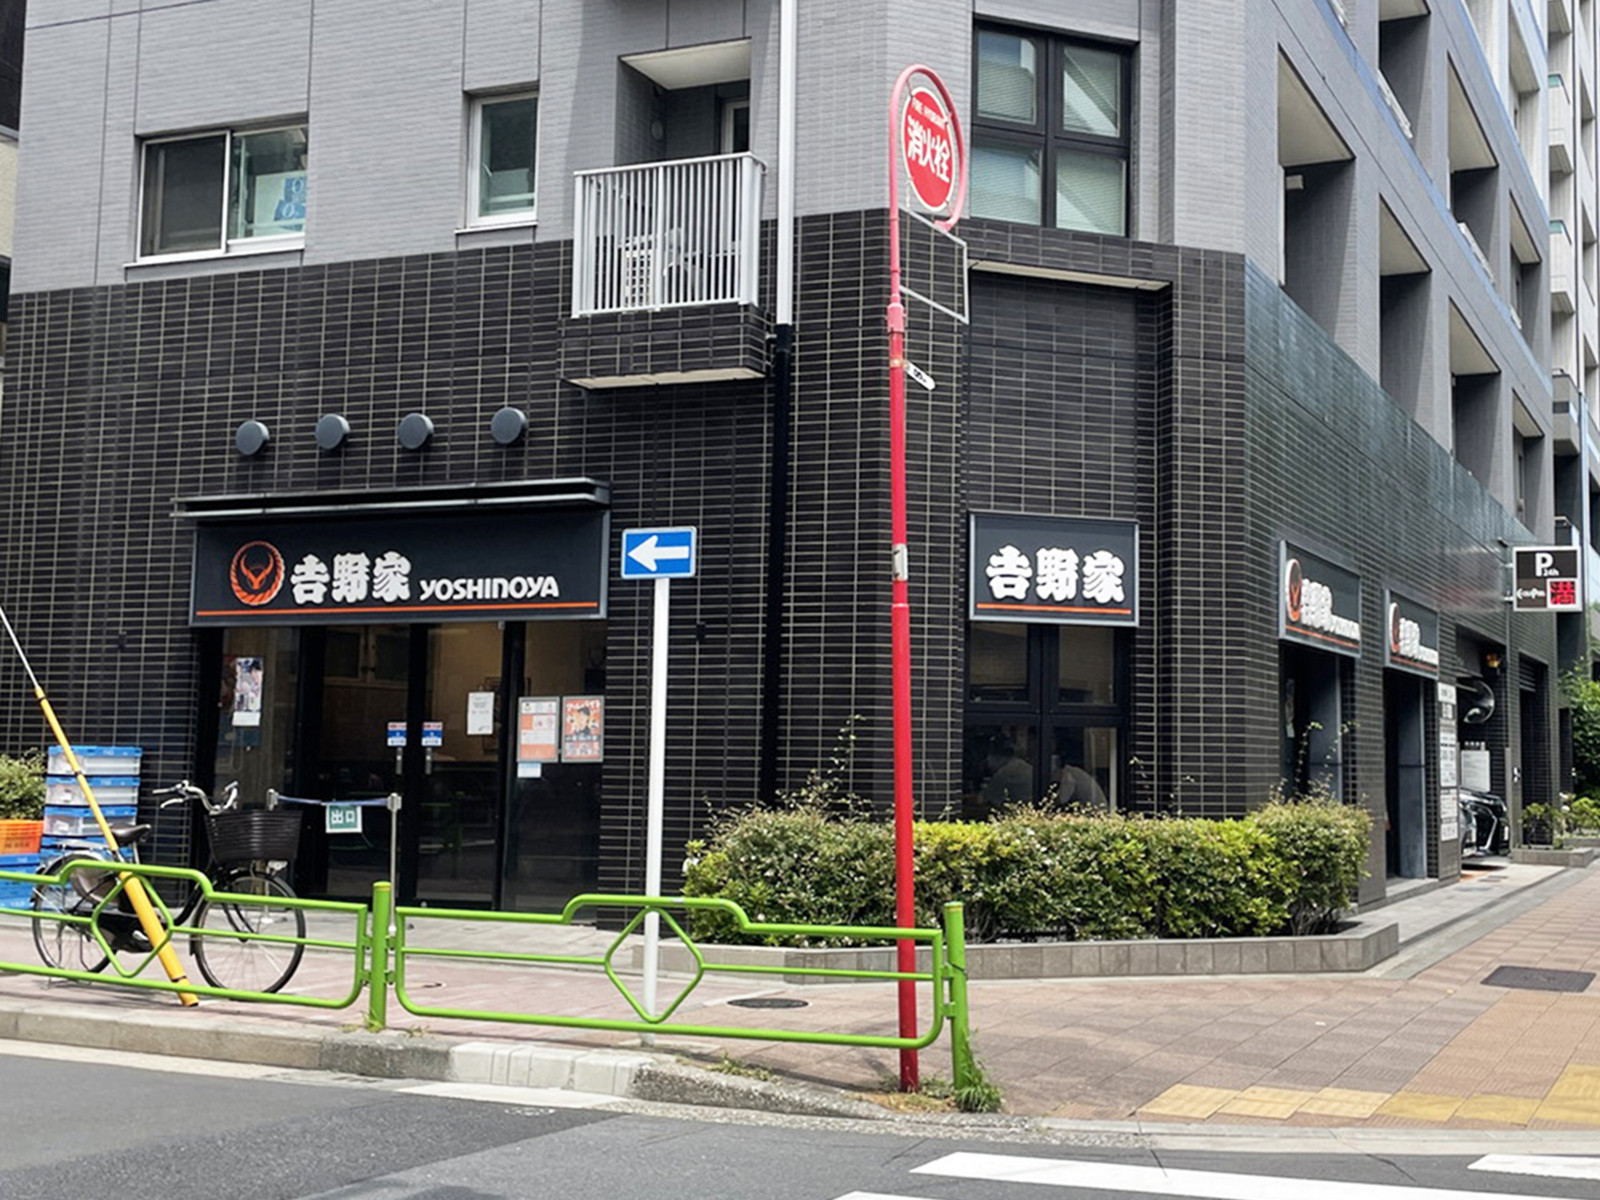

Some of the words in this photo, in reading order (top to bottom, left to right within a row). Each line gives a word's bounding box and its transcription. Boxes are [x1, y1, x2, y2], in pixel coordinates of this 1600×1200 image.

[907, 115, 950, 183] 消火栓
[1535, 552, 1553, 577] P
[419, 576, 560, 601] YOSHINOYA
[330, 808, 356, 825] 出口
